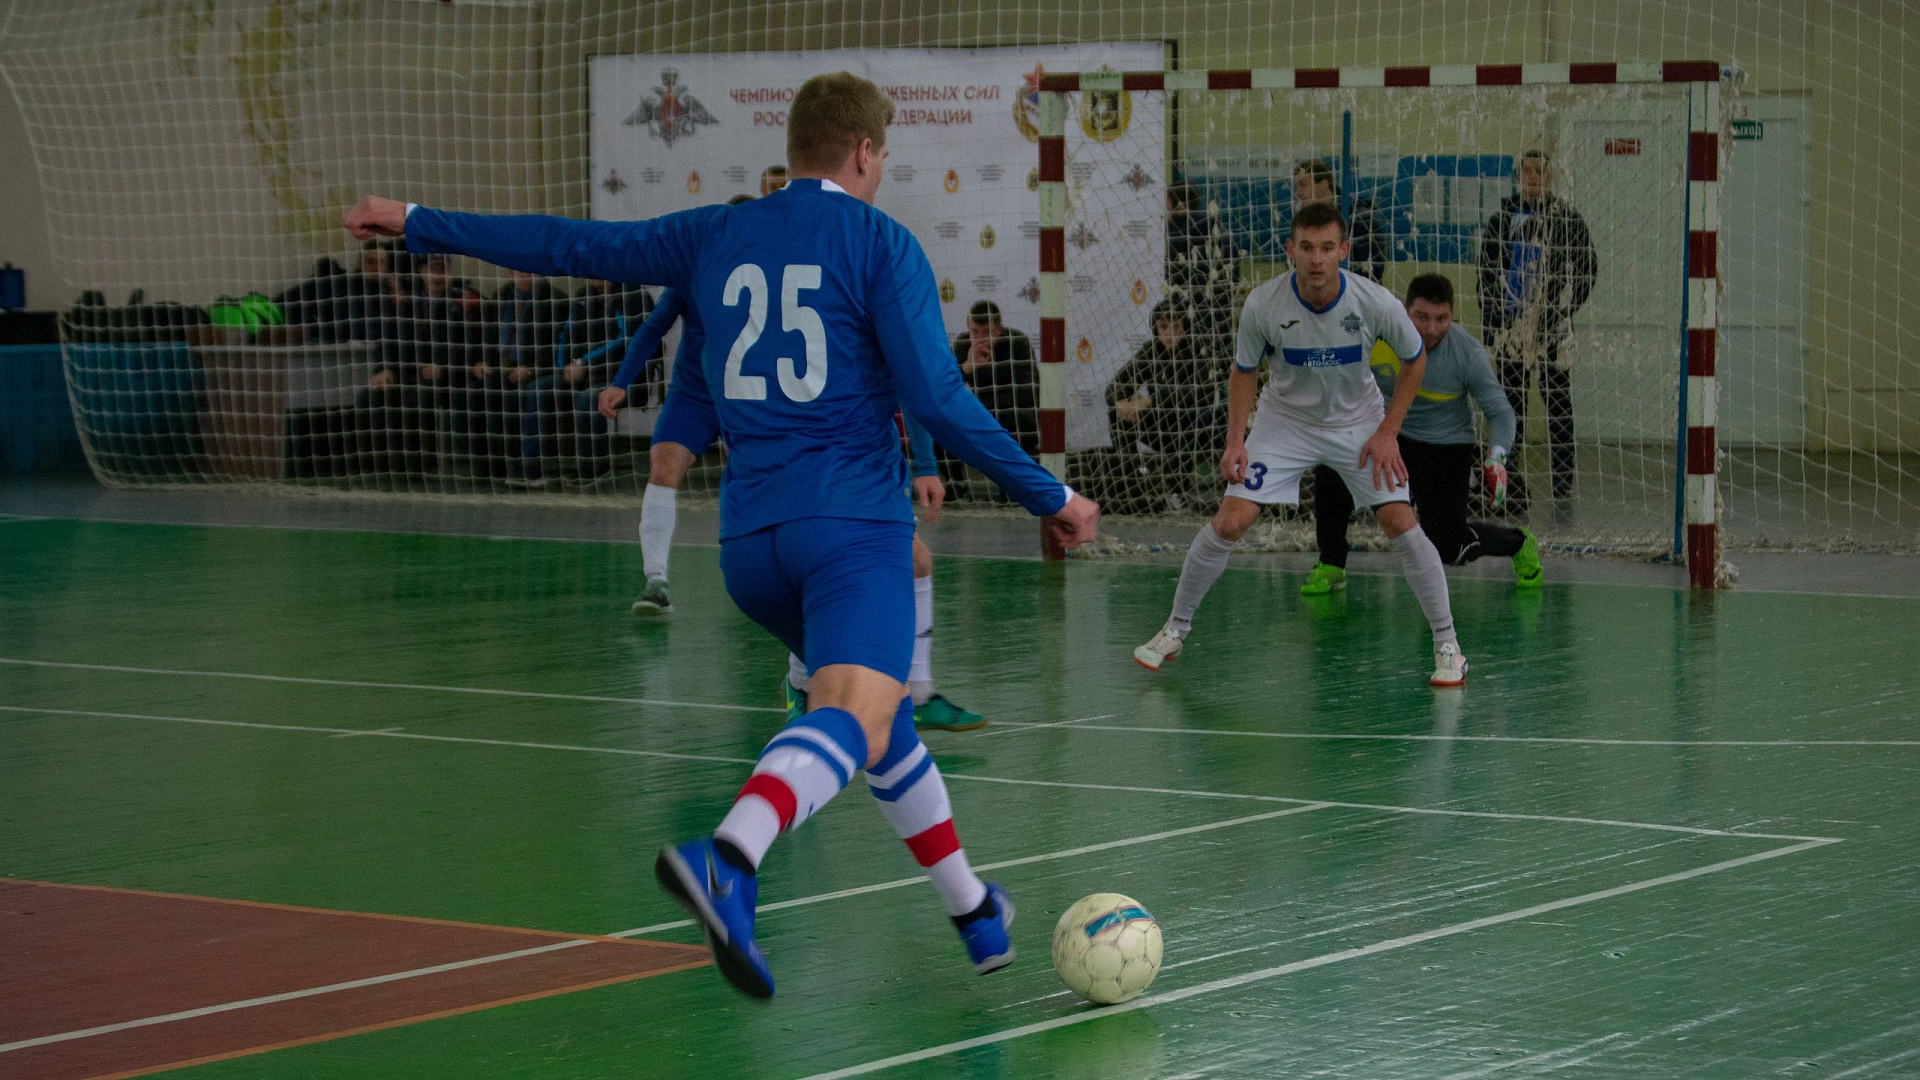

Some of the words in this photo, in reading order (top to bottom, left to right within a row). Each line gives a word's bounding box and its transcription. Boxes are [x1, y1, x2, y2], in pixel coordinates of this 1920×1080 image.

[963, 84, 999, 100] СИЛ
[753, 111, 786, 126] РОС
[890, 109, 972, 125] ЕДЕРАЦИИ
[722, 263, 828, 402] 25
[1244, 461, 1268, 491] 3
